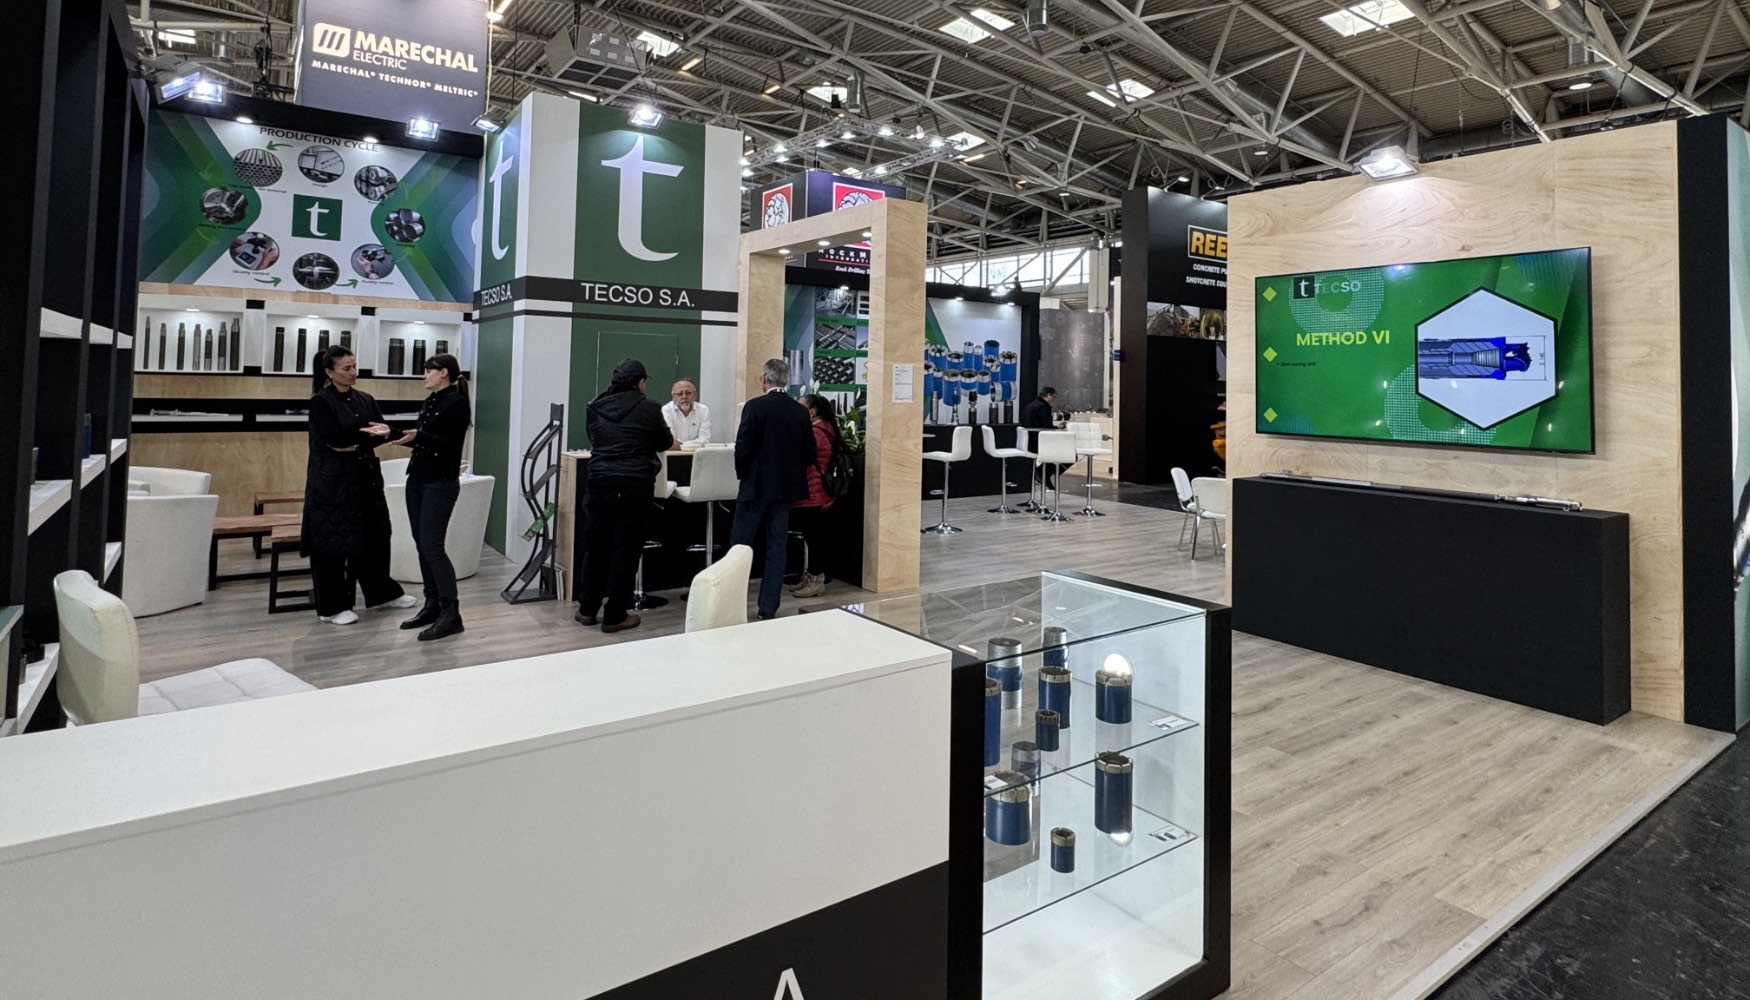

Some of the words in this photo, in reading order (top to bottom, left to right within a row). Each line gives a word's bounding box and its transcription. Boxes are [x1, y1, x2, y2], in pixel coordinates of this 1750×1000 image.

[353, 51, 407, 70] ELECTRIC
[354, 31, 478, 72] MARECHAL
[260, 127, 341, 147] PRODUCTION
[344, 140, 379, 152] CYCLE
[1193, 263, 1220, 274] CONCRETE
[1186, 276, 1216, 286] SHOTCRETE
[480, 287, 500, 306] TECSO
[581, 282, 653, 305] TECSO
[659, 289, 695, 307] S.A.
[1296, 332, 1368, 346] METHOD
[1372, 330, 1390, 344] VI
